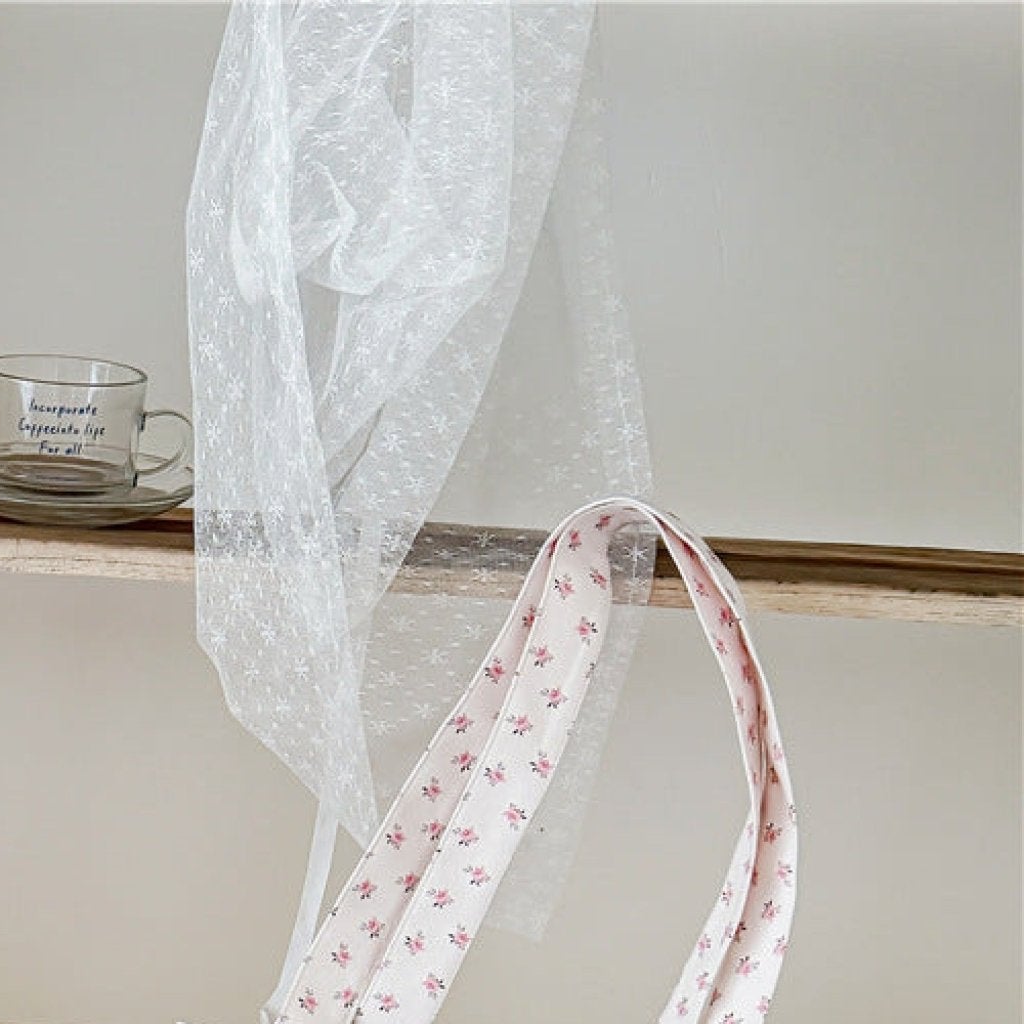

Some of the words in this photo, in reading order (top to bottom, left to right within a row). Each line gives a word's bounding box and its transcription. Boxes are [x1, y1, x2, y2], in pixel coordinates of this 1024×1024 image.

[29, 399, 98, 418] Incorporate
[39, 440, 59, 455] For
[65, 442, 82, 455] all
